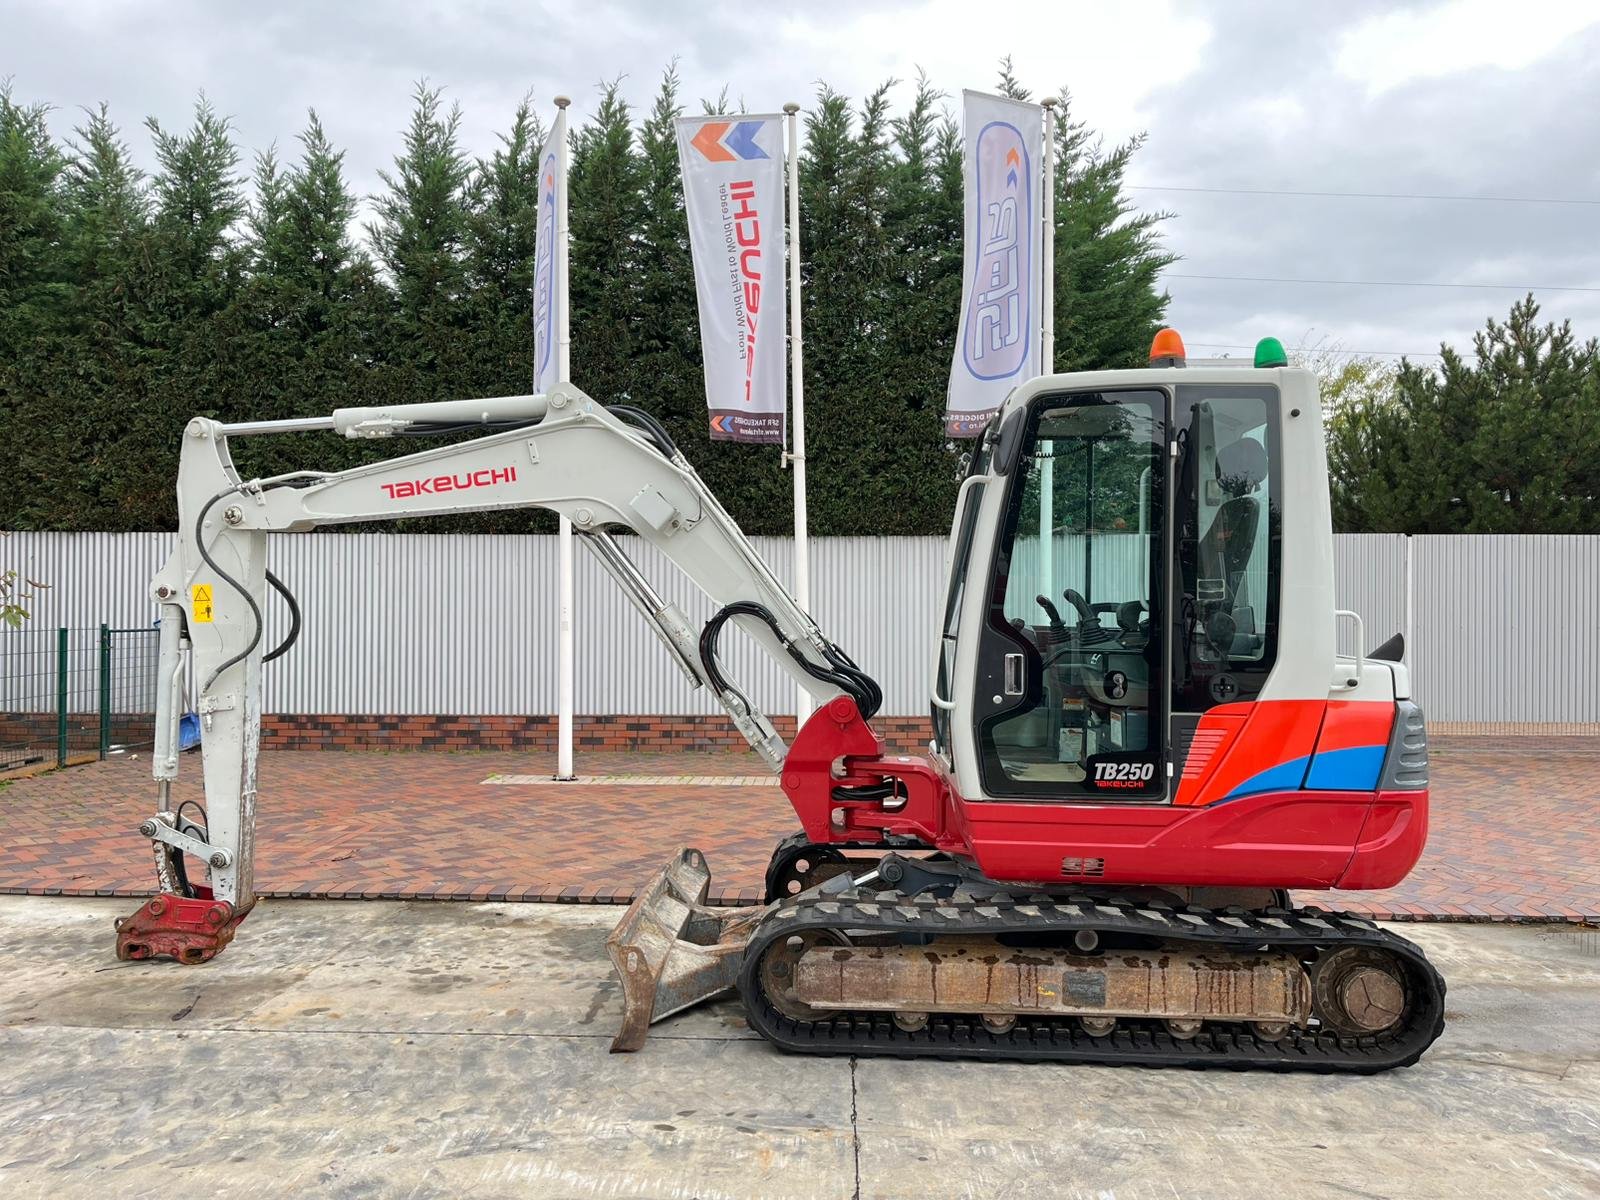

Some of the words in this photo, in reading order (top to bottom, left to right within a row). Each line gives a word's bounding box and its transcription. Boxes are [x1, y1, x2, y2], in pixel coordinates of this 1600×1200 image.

[381, 466, 517, 499] TAKEUCHI
[1094, 763, 1155, 780] TB250
[1094, 780, 1145, 788] TAKEUCHI
